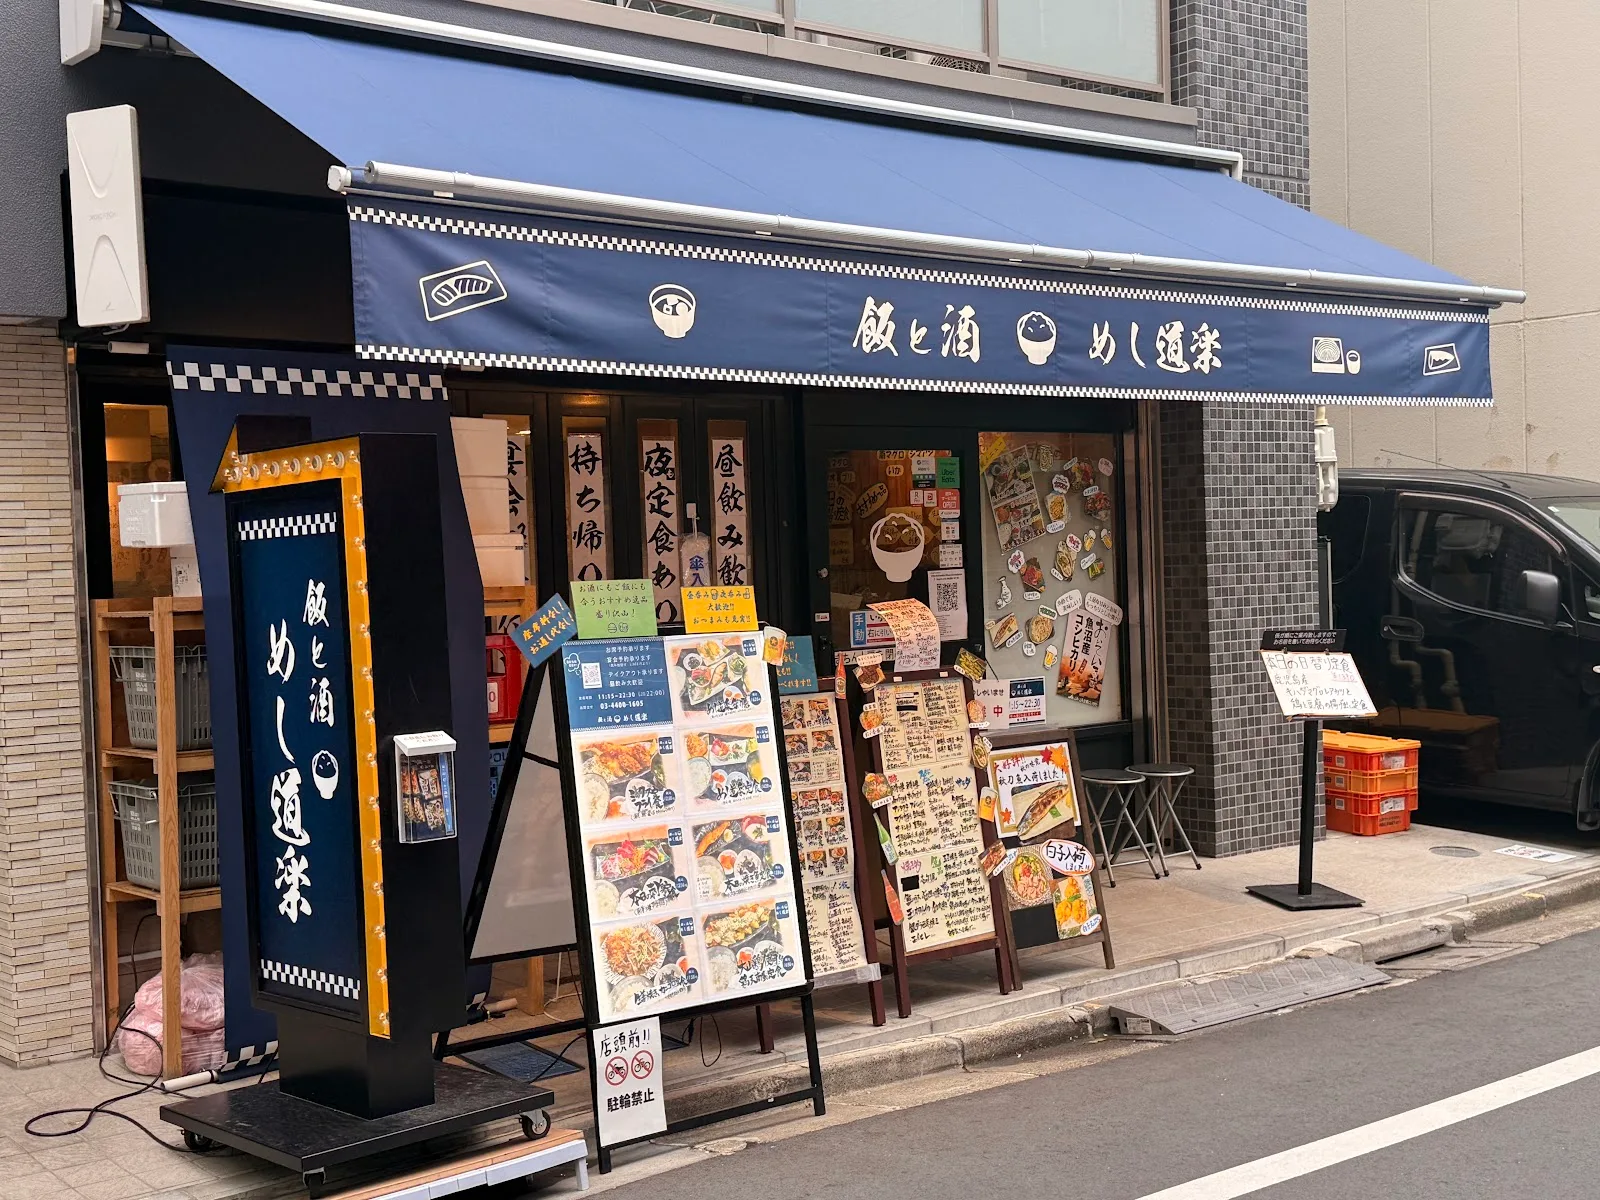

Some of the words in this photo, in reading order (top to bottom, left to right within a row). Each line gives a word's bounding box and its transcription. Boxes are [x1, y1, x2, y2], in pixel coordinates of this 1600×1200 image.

[852, 296, 981, 363] 飯と酒
[1088, 320, 1222, 374] めし道楽
[530, 612, 574, 654] お通し代なし！
[855, 614, 865, 641] 手動
[1081, 617, 1094, 656] 魚沼産
[303, 578, 335, 728] 飯と酒
[993, 705, 1003, 717] 中
[267, 618, 313, 924] めし道楽
[1046, 841, 1086, 864] 白子入荷
[600, 1028, 651, 1058] 店頭前！！
[607, 1087, 655, 1112] 駐輪禁止
